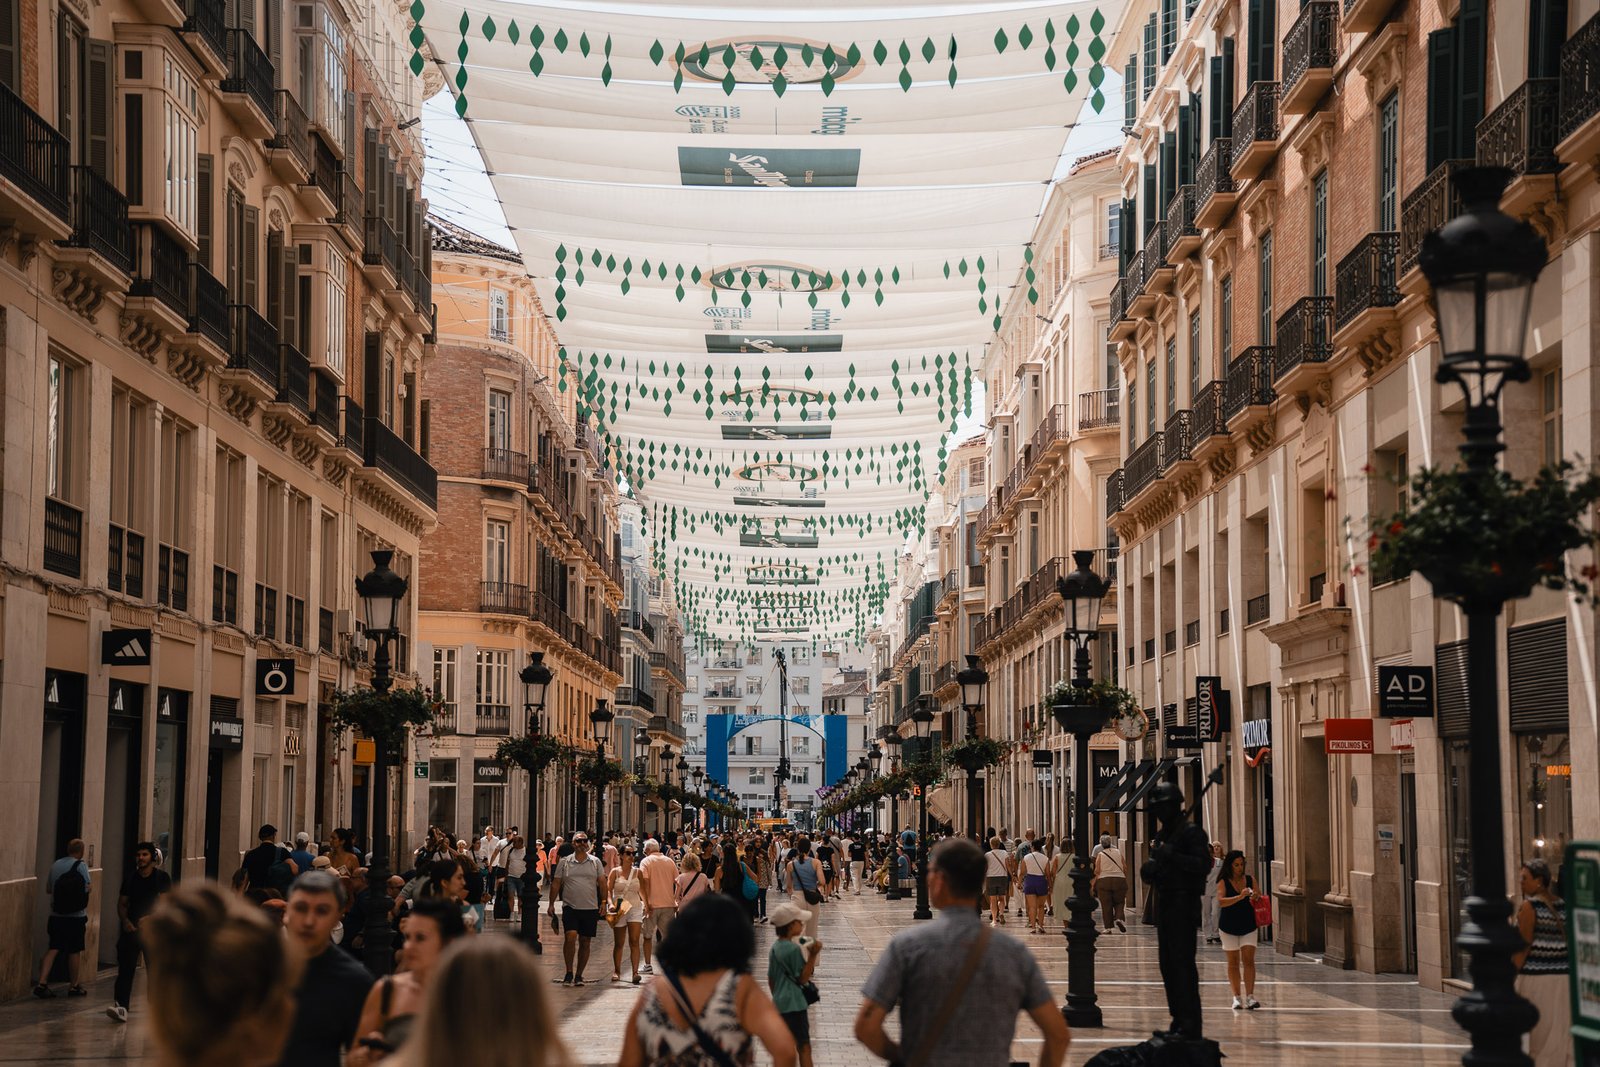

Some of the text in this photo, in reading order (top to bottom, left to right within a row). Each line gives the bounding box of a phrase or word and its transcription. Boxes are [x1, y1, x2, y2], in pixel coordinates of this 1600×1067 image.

[1386, 674, 1426, 693] AD
[1199, 680, 1211, 739] PRIMOR
[1241, 719, 1269, 748] PRIMOR
[1331, 741, 1361, 749] PIKOLINOS
